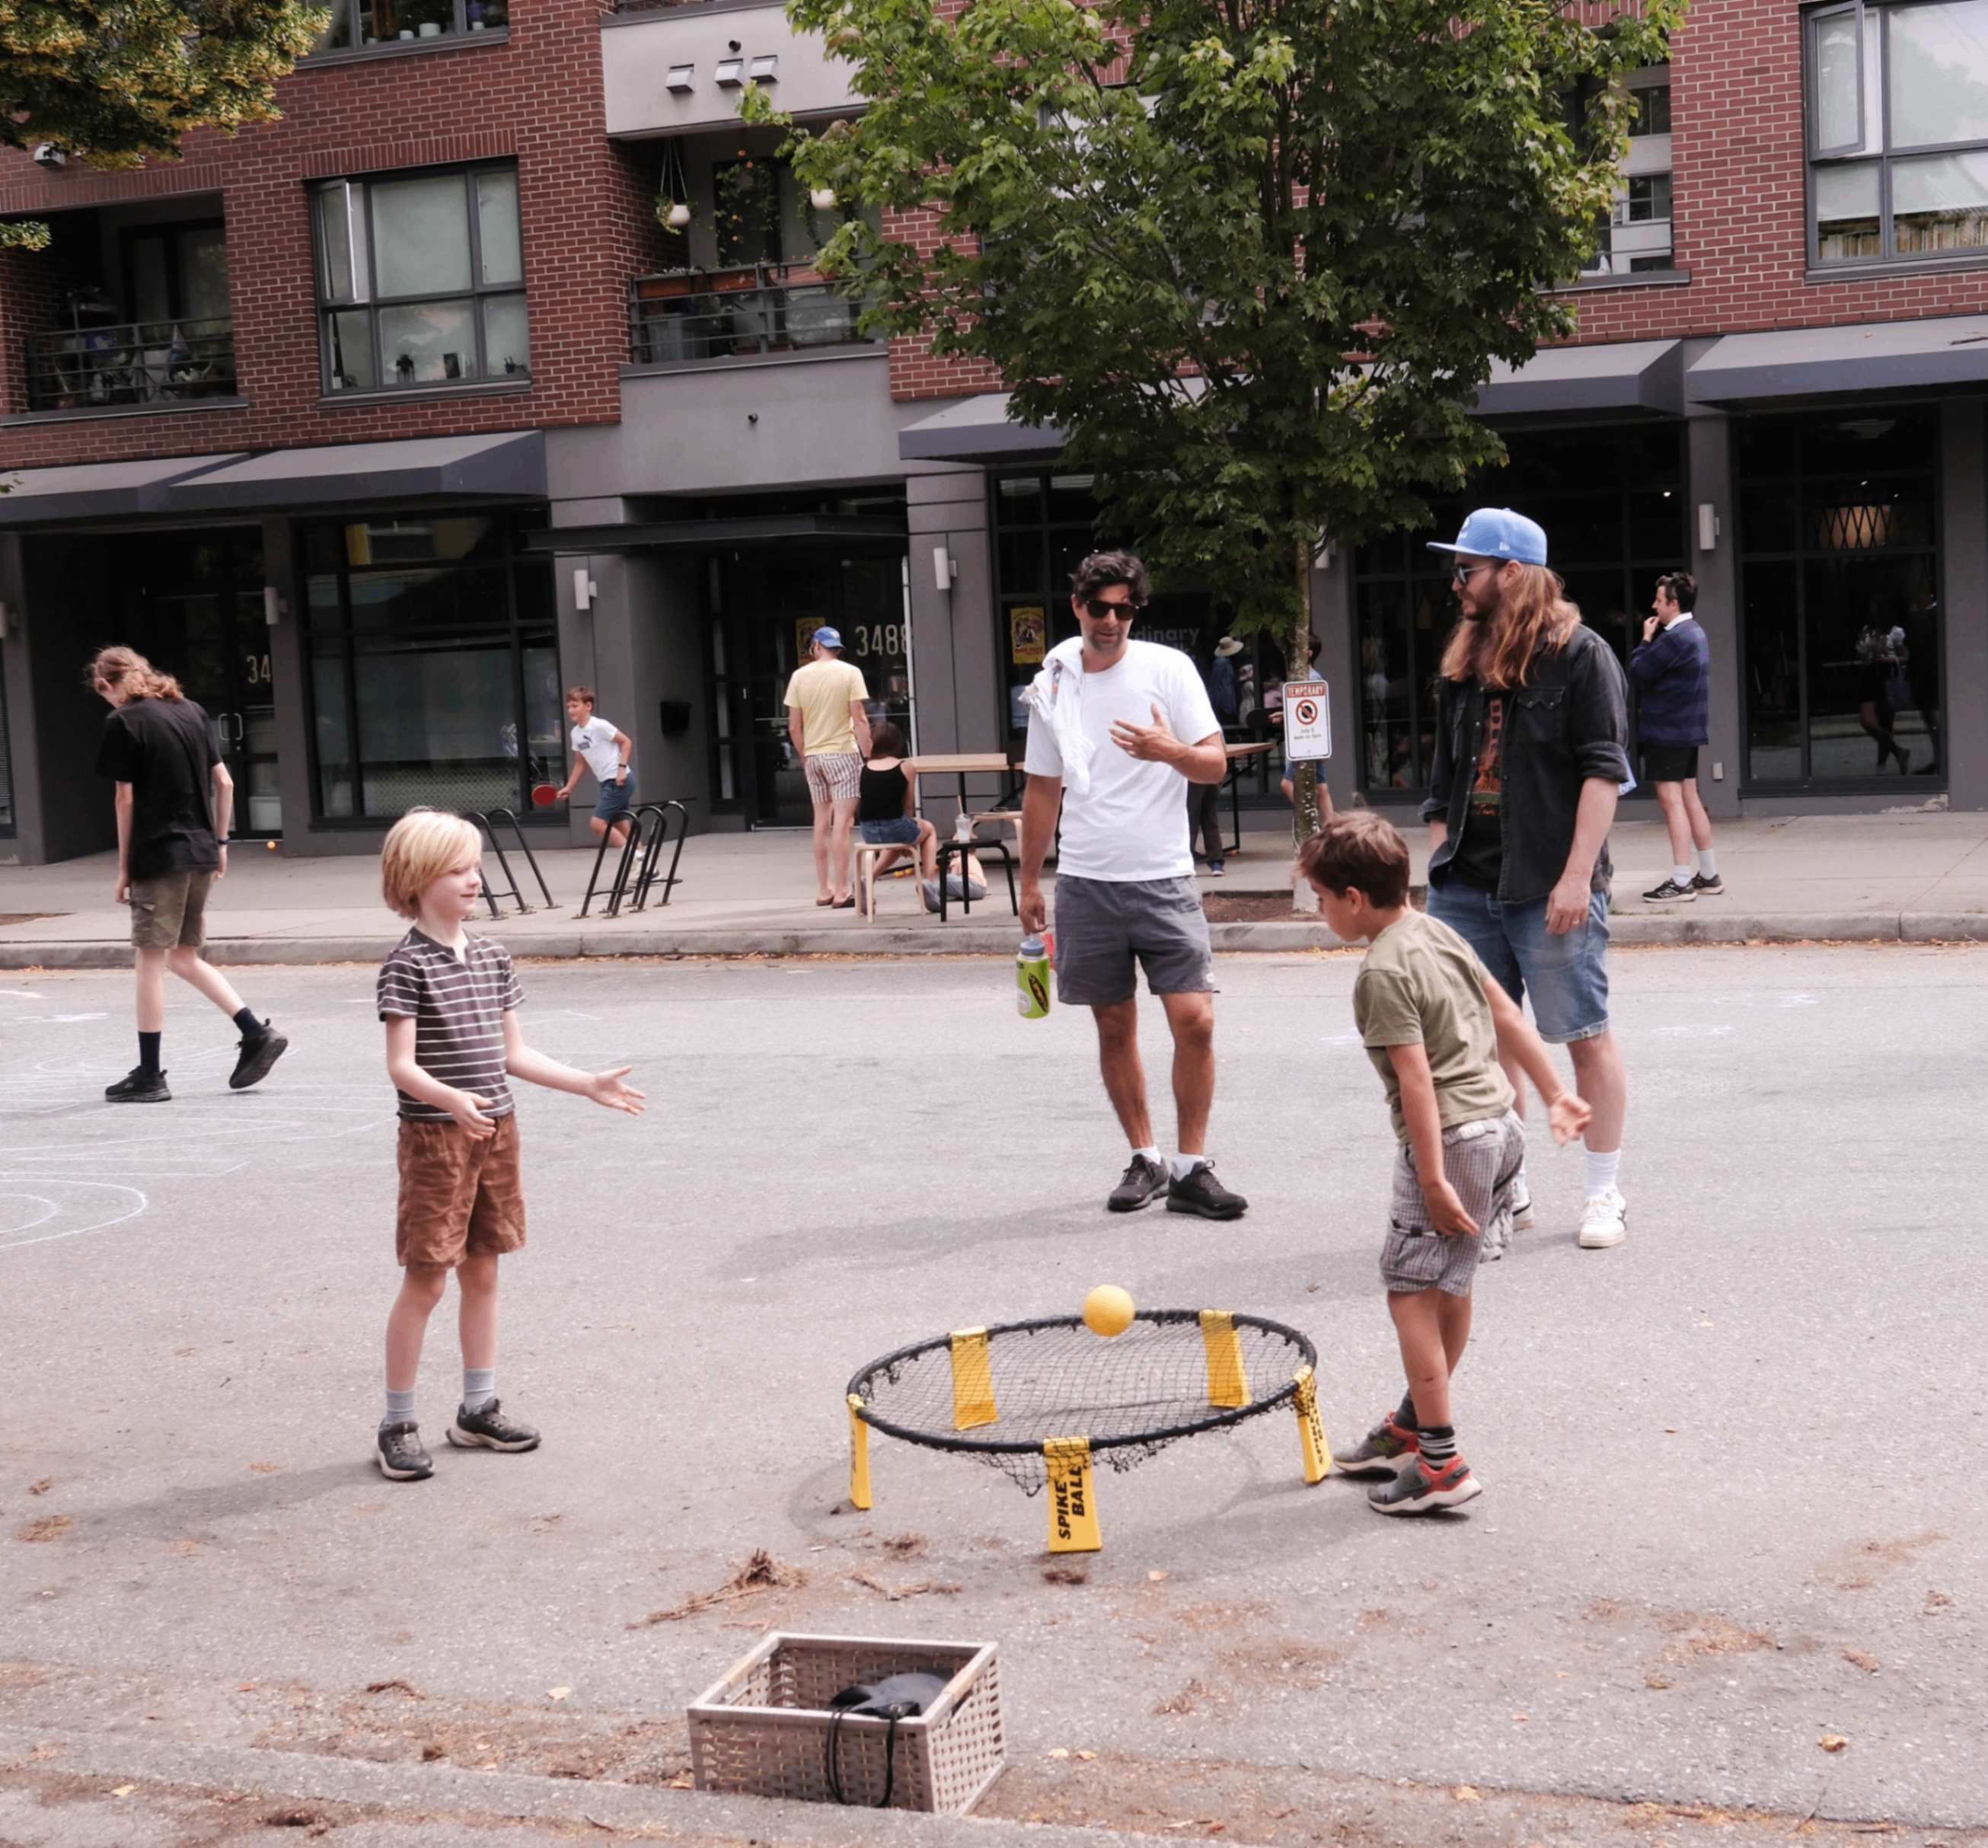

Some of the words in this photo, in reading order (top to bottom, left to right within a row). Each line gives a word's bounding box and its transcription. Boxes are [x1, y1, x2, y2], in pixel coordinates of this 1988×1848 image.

[1129, 624, 1200, 646] dinary
[1288, 685, 1324, 697] TEMPORARY
[1055, 1479, 1071, 1540] SPIKE
[1068, 1466, 1085, 1517] BALL
